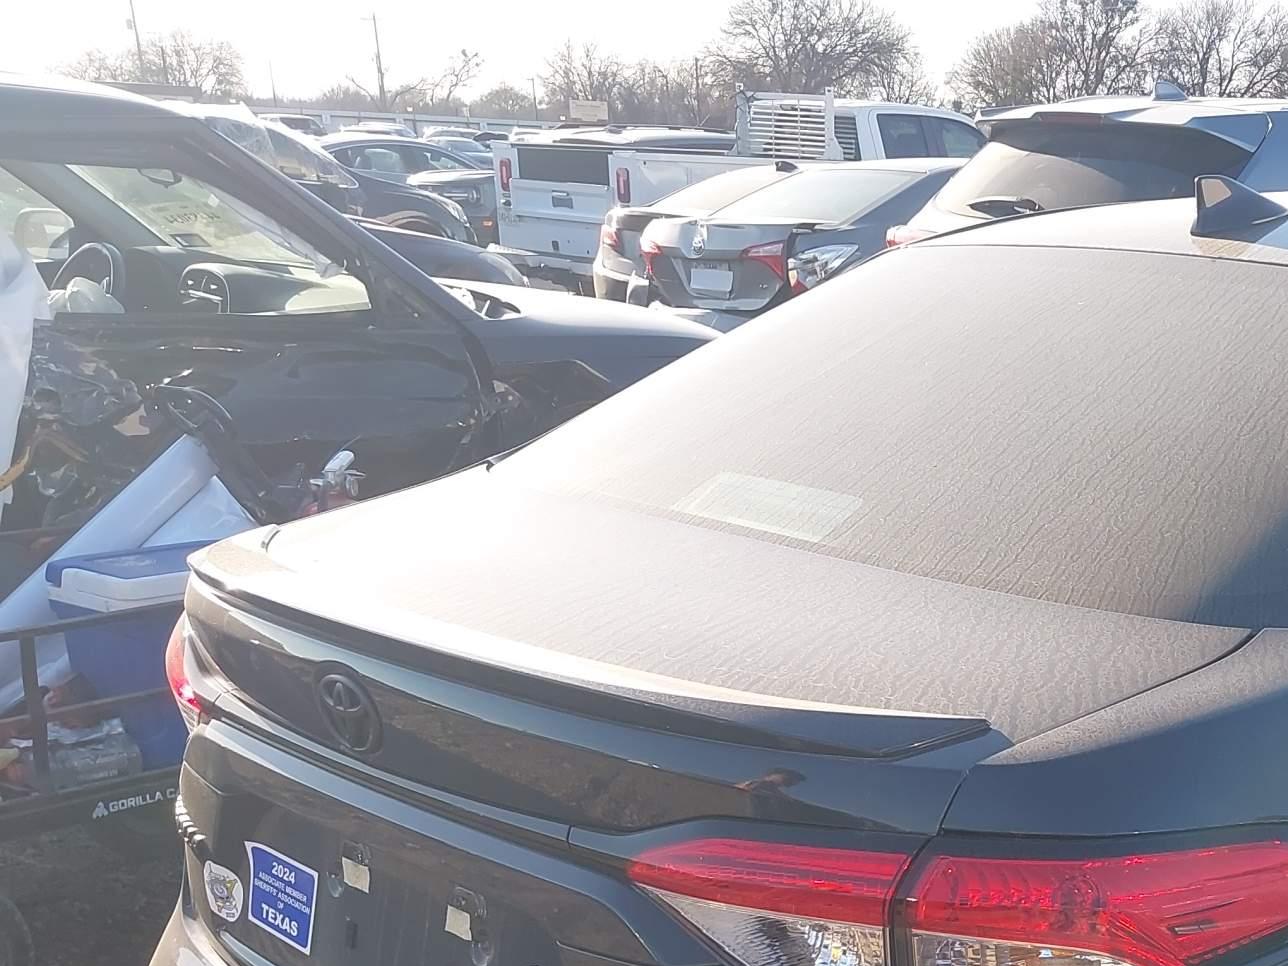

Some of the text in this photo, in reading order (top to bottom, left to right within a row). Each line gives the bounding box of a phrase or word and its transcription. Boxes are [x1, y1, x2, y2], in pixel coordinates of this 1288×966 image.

[109, 791, 163, 812] GORILLA
[271, 861, 296, 885] 2024
[258, 871, 308, 904] ASSOCIATE MEMBER
[276, 901, 284, 910] OF
[277, 890, 311, 915] ASSOCIATION
[261, 902, 299, 938] TEXAS
